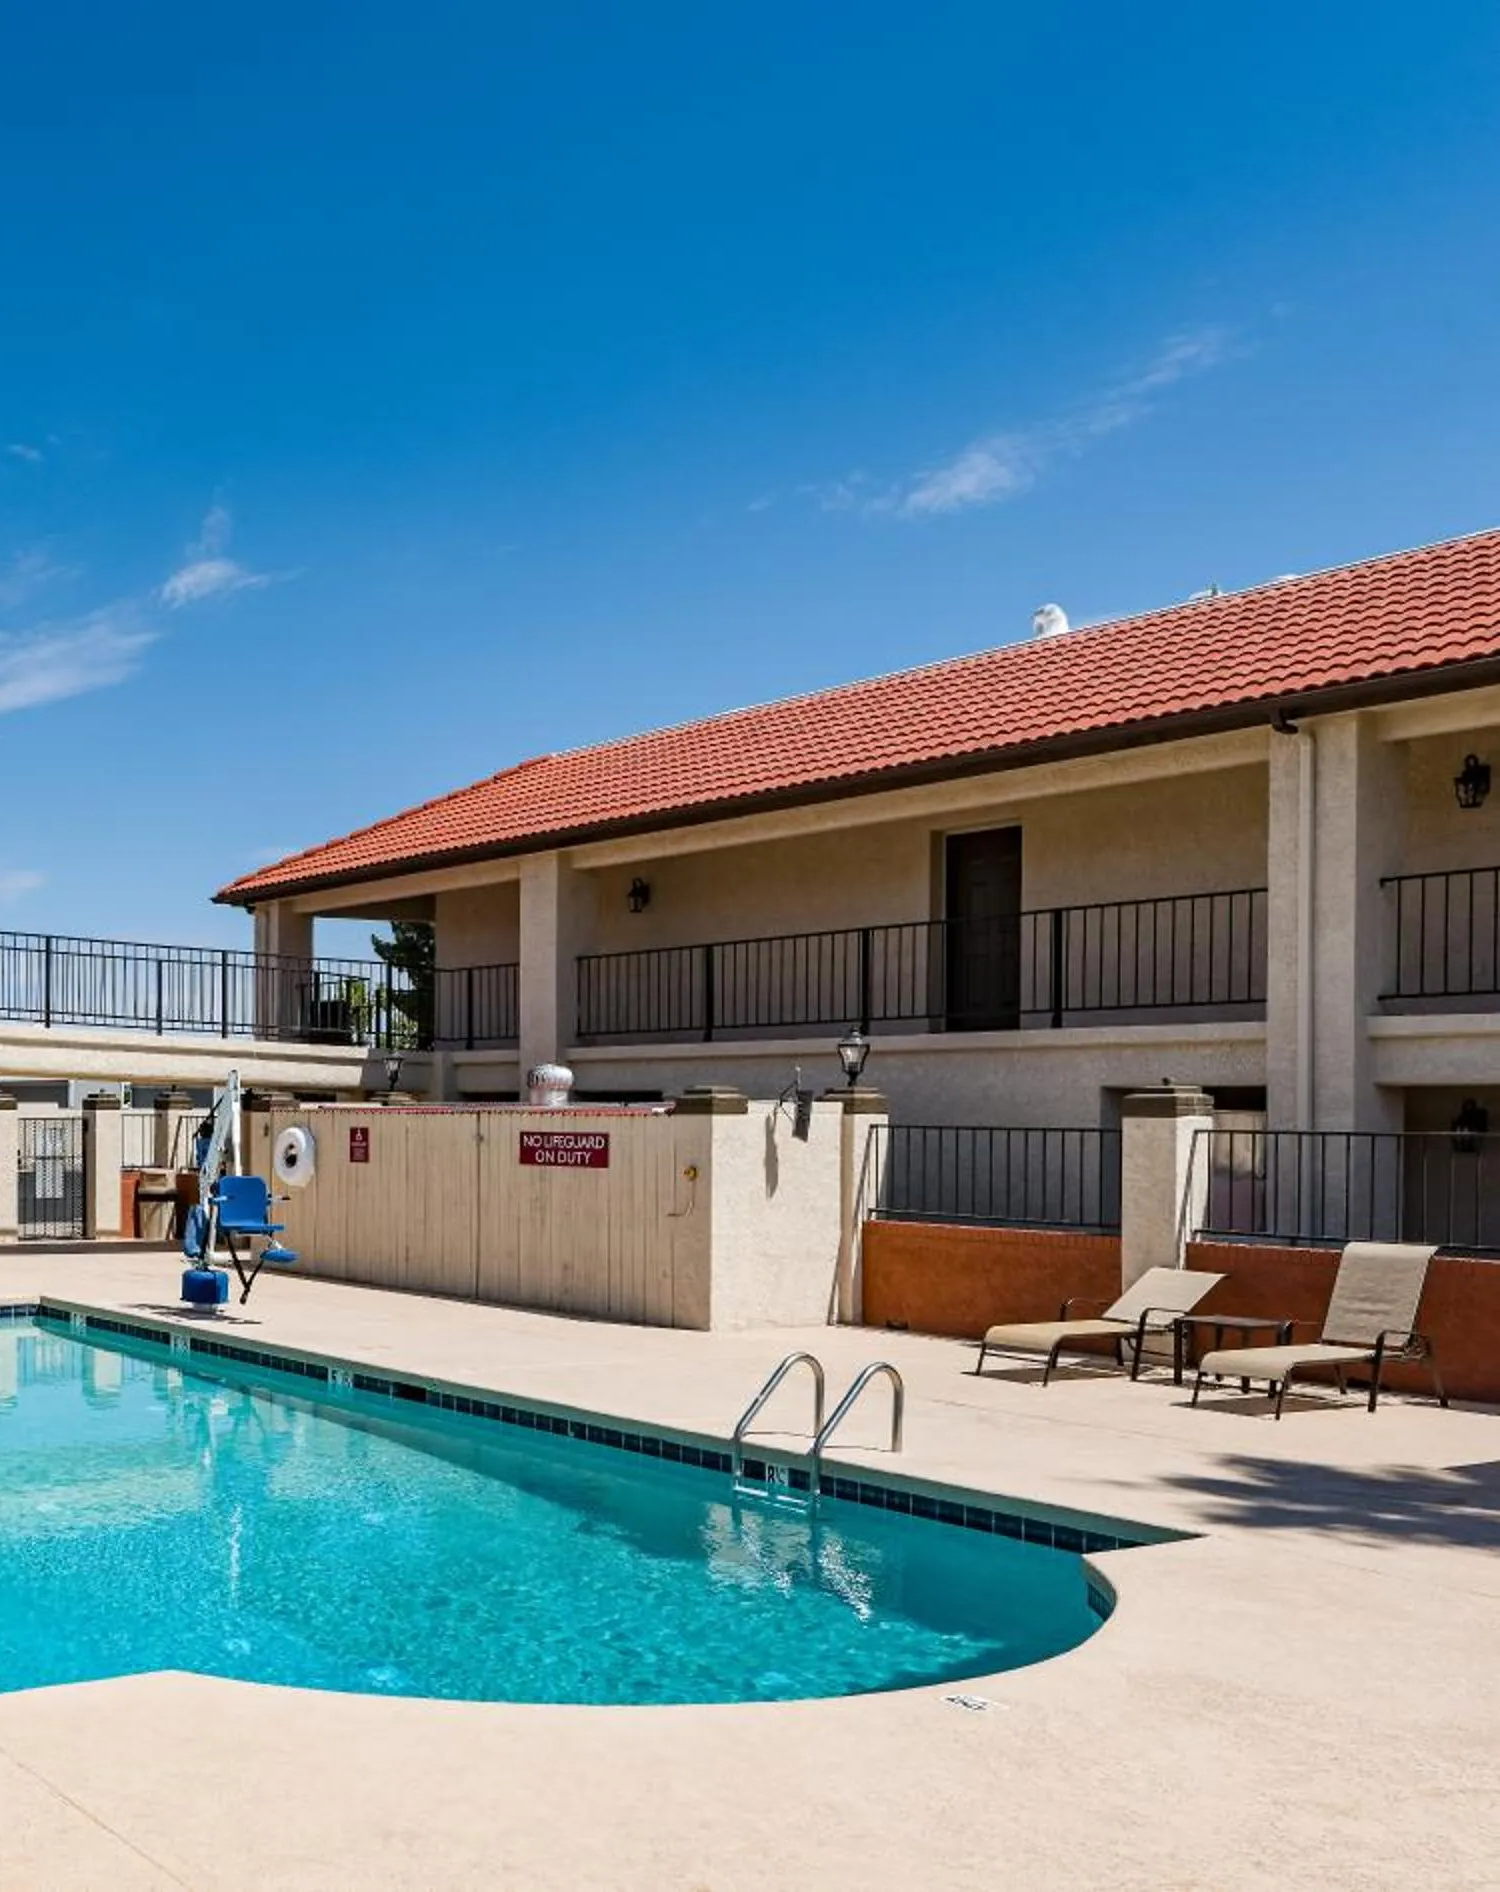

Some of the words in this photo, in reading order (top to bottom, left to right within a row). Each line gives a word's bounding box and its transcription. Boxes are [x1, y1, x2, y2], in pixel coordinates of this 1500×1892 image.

[523, 1135, 542, 1147] NO
[543, 1135, 605, 1149] LIFEGUARD
[535, 1150, 555, 1163] ON
[557, 1151, 591, 1164] DUTY
